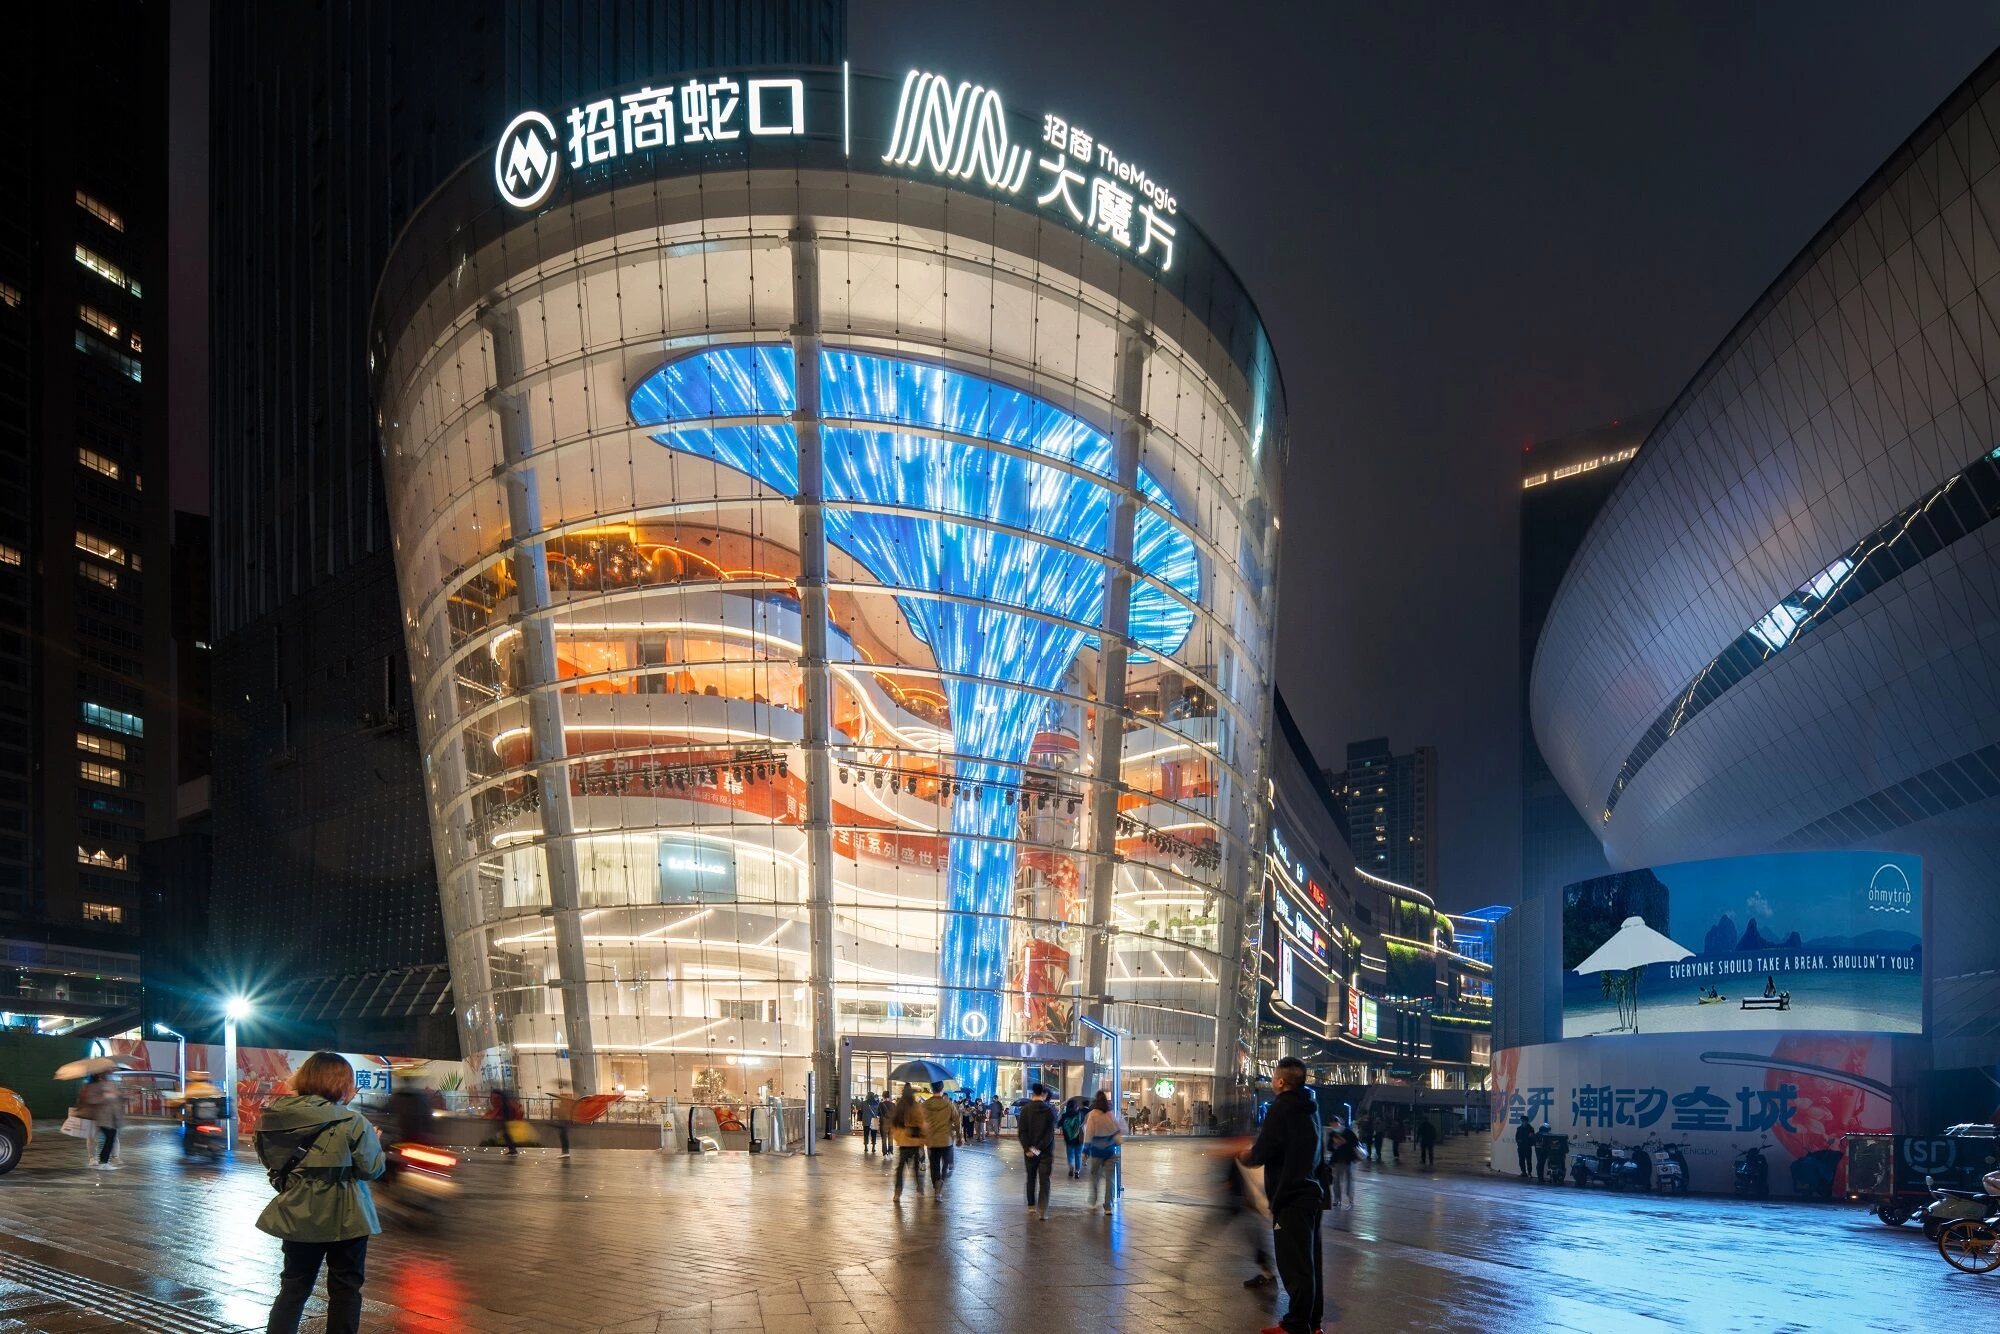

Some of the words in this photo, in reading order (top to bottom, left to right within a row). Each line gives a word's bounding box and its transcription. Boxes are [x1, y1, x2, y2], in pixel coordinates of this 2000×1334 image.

[566, 76, 805, 170] 招商蛇口
[1043, 113, 1093, 163] 招商
[1097, 143, 1178, 215] TheMagic
[1037, 153, 1177, 272] 大魔方
[1868, 886, 1912, 906] ohmytrip
[1669, 961, 1714, 979] EVERYONE
[1718, 959, 1753, 975] SHOULD
[1757, 957, 1780, 972] TAKE
[1784, 956, 1790, 970] A
[1794, 955, 1828, 970] BREAK.
[1832, 954, 1886, 969] SHOULDN'T
[1890, 956, 1914, 970] YOU?
[1572, 1083, 1798, 1133] 潮动全城
